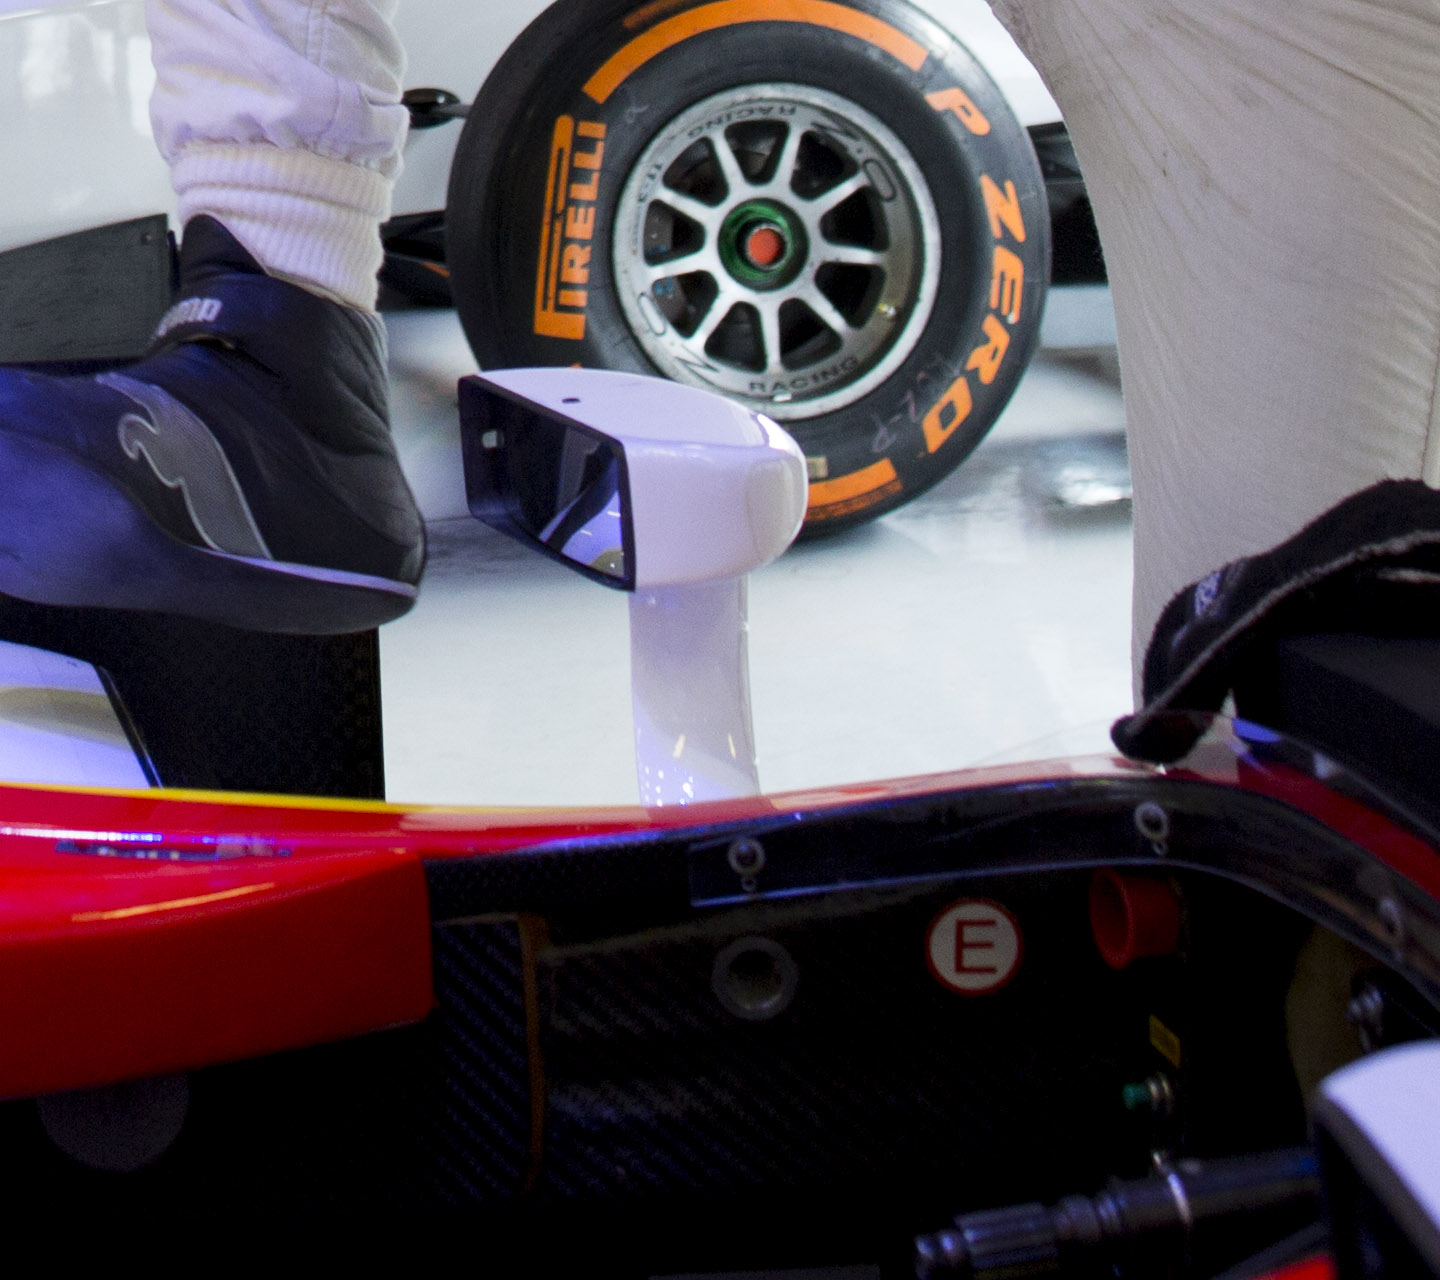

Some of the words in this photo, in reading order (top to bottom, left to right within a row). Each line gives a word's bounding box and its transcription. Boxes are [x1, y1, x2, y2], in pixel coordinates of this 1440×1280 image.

[925, 88, 990, 135] P
[533, 114, 607, 339] PIRELLI
[921, 175, 1026, 453] ZERO
[749, 356, 860, 393] RACING
[955, 919, 997, 974] E
